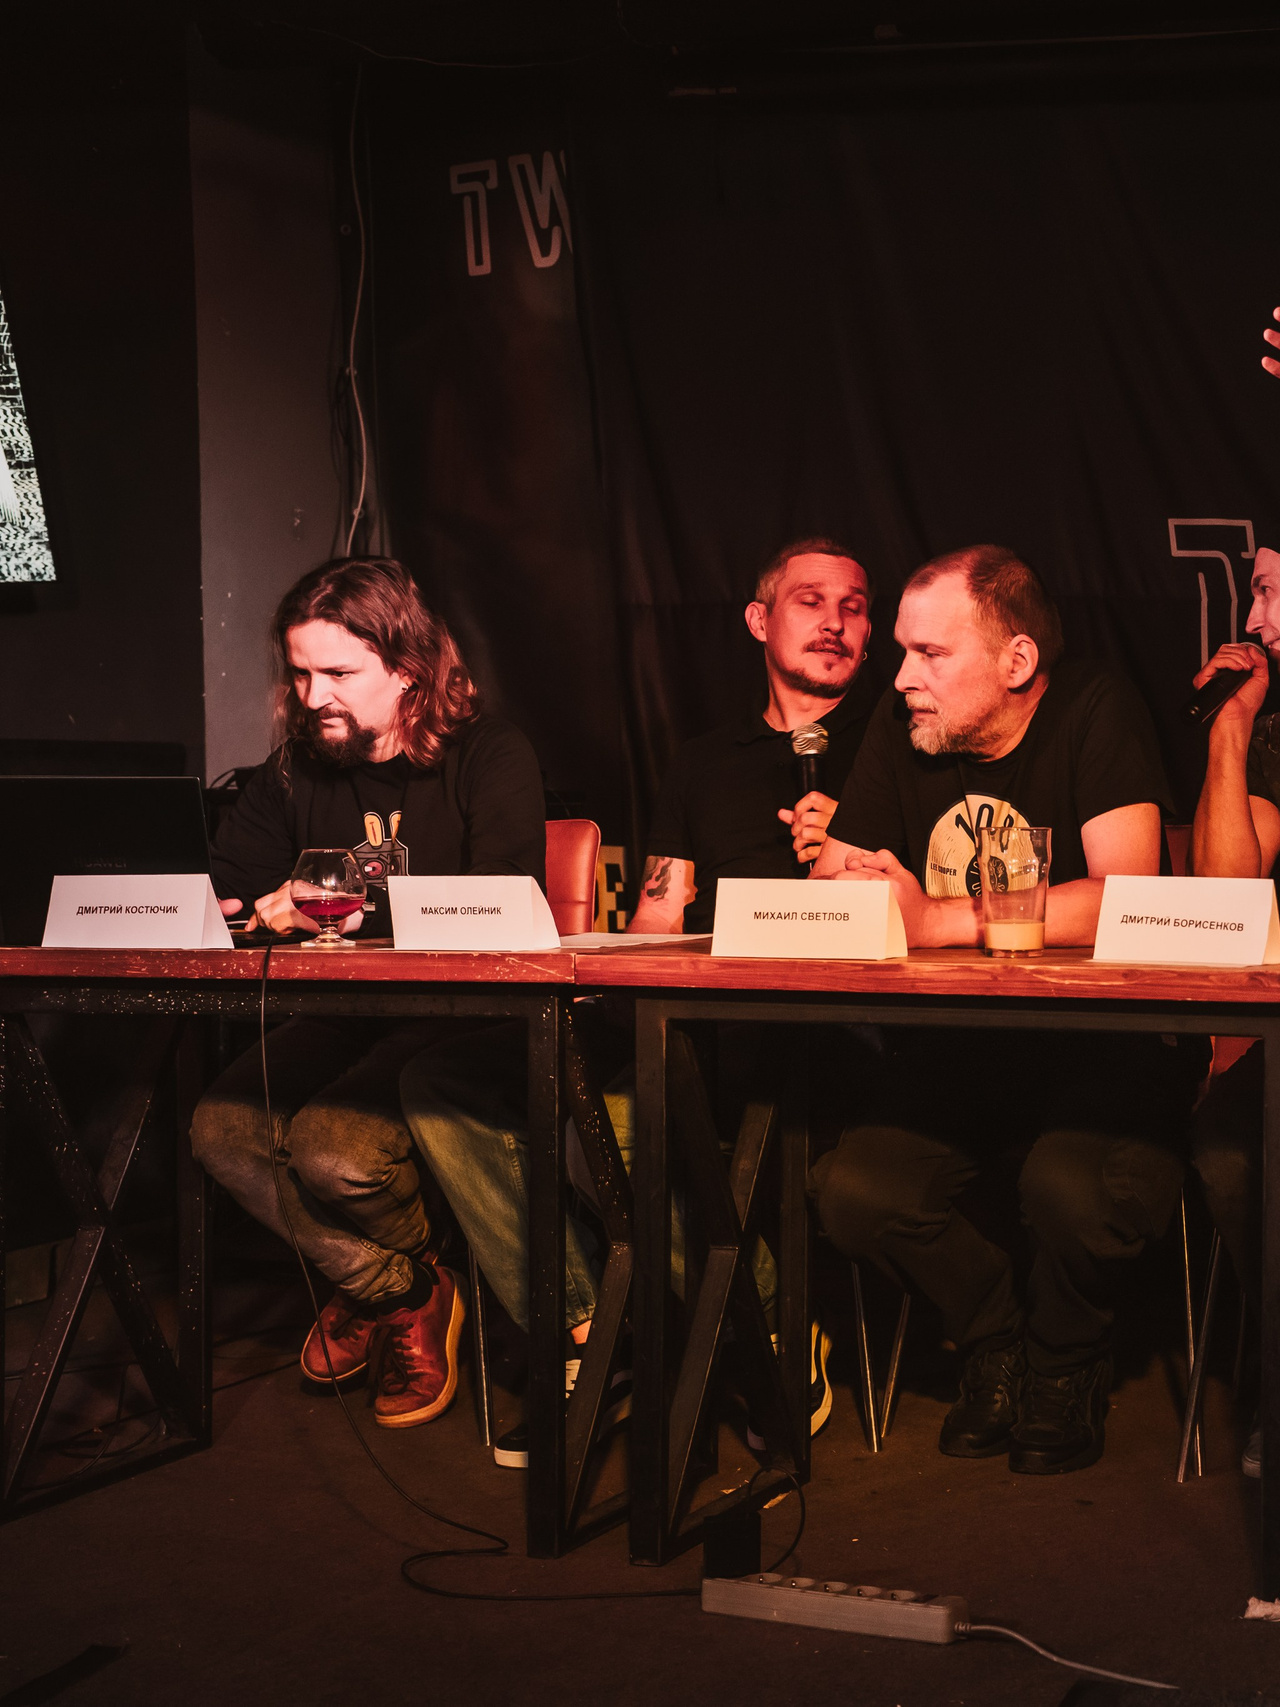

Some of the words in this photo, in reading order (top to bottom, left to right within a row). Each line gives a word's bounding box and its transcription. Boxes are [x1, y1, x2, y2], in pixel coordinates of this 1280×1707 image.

[76, 904, 123, 916] ДМИТРИЙ
[125, 905, 179, 915] КОСТЮЧИК
[421, 906, 458, 916] МАКСИМ
[460, 905, 502, 916] ОЛЕЙНИК
[753, 911, 798, 921] МИХАИЛ
[800, 912, 850, 922] СВЕТЛОВ
[1120, 914, 1171, 927] ДМИТРИЙ
[1173, 918, 1245, 932] БОРИСЕНКОВ
